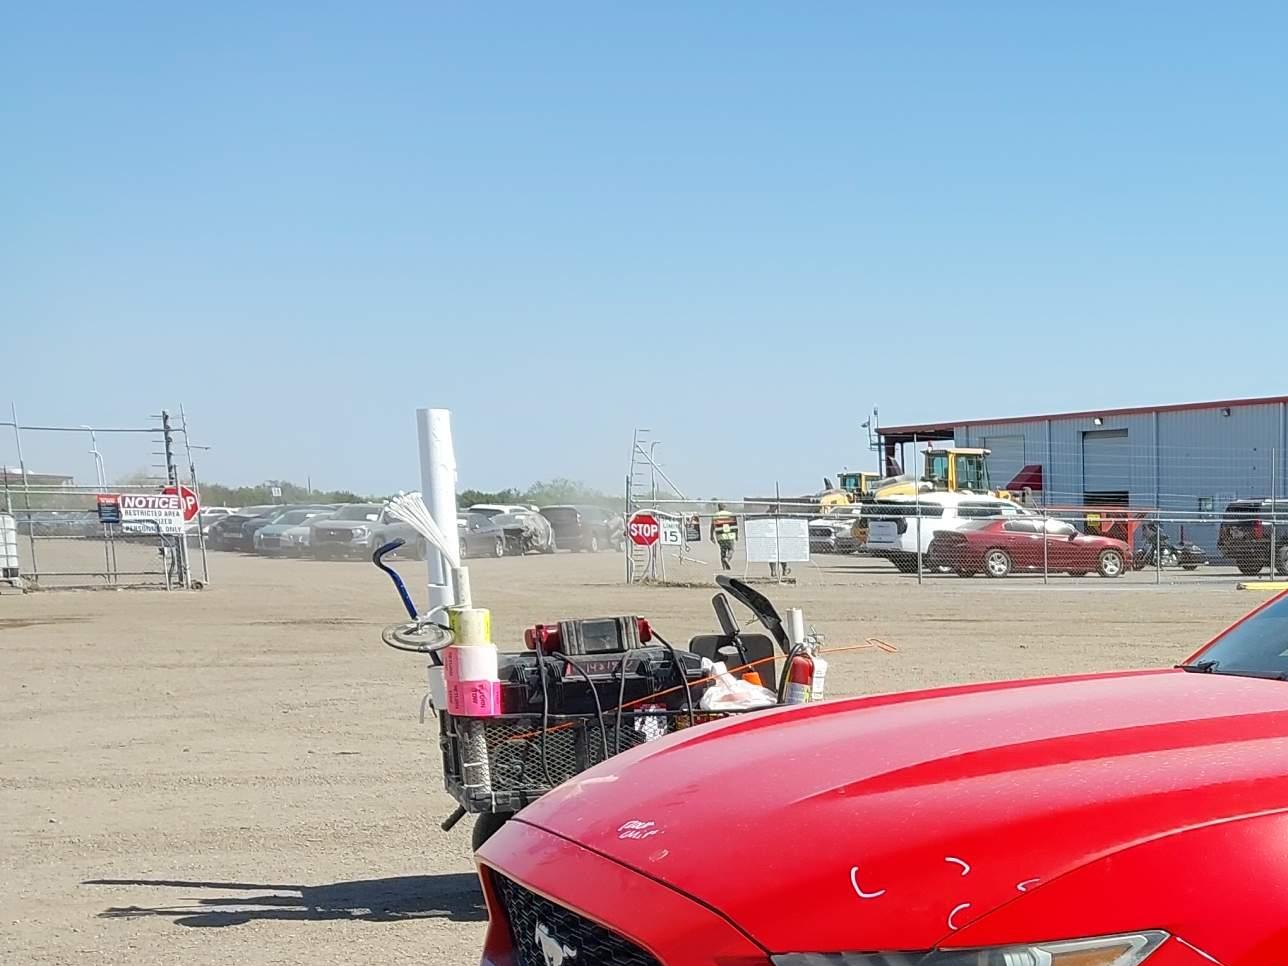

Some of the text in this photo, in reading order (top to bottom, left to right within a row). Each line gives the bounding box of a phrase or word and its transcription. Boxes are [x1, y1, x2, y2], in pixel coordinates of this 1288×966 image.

[124, 497, 179, 508] NOTICE
[630, 522, 658, 537] STOP
[664, 530, 678, 542] 15
